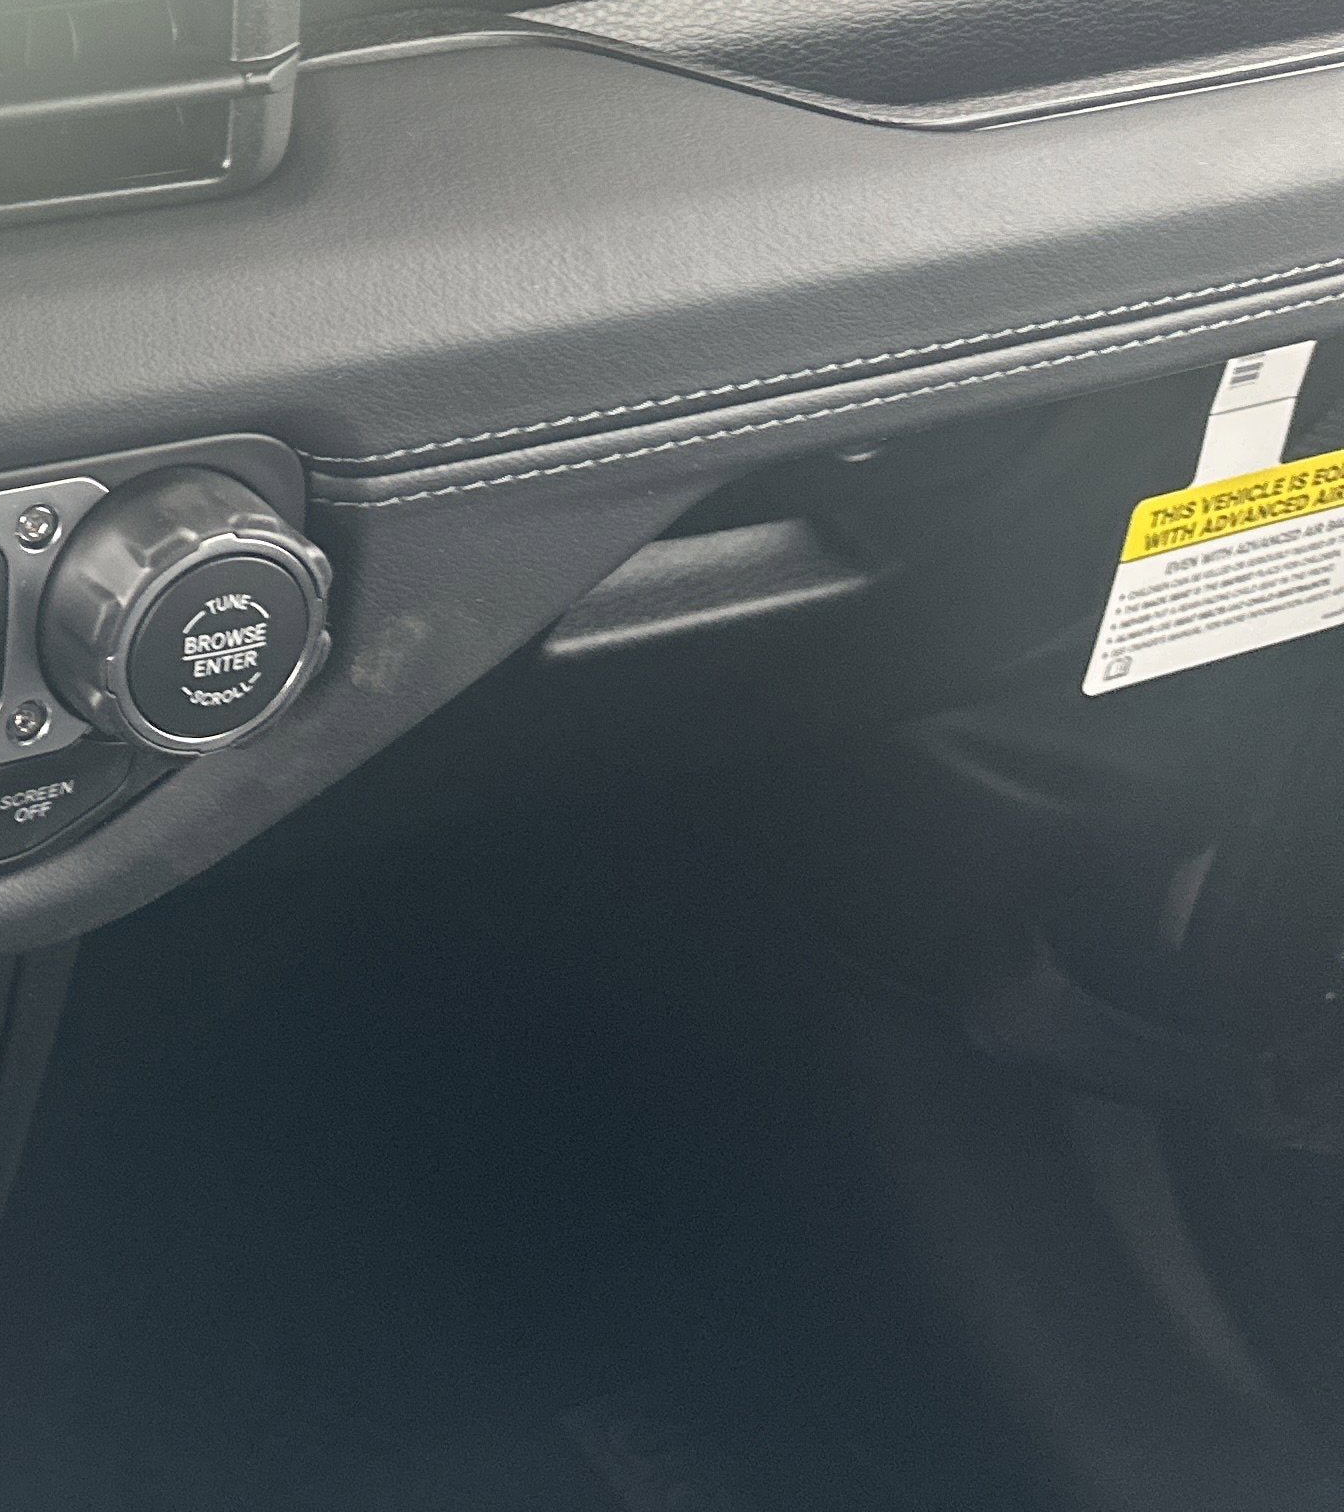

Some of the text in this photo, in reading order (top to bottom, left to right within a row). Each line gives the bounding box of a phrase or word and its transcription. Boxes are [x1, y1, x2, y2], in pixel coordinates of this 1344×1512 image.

[1150, 501, 1197, 528] THIS
[1201, 477, 1285, 514] VEHICLE
[1288, 472, 1310, 492] IS
[1145, 522, 1197, 551] WITH
[1199, 494, 1310, 536] ADVANCED
[205, 593, 252, 615] TUNE
[183, 622, 267, 655] BROWSE
[193, 650, 258, 678] ENTER
[189, 681, 254, 707] SCROLL
[13, 802, 51, 824] OFF
